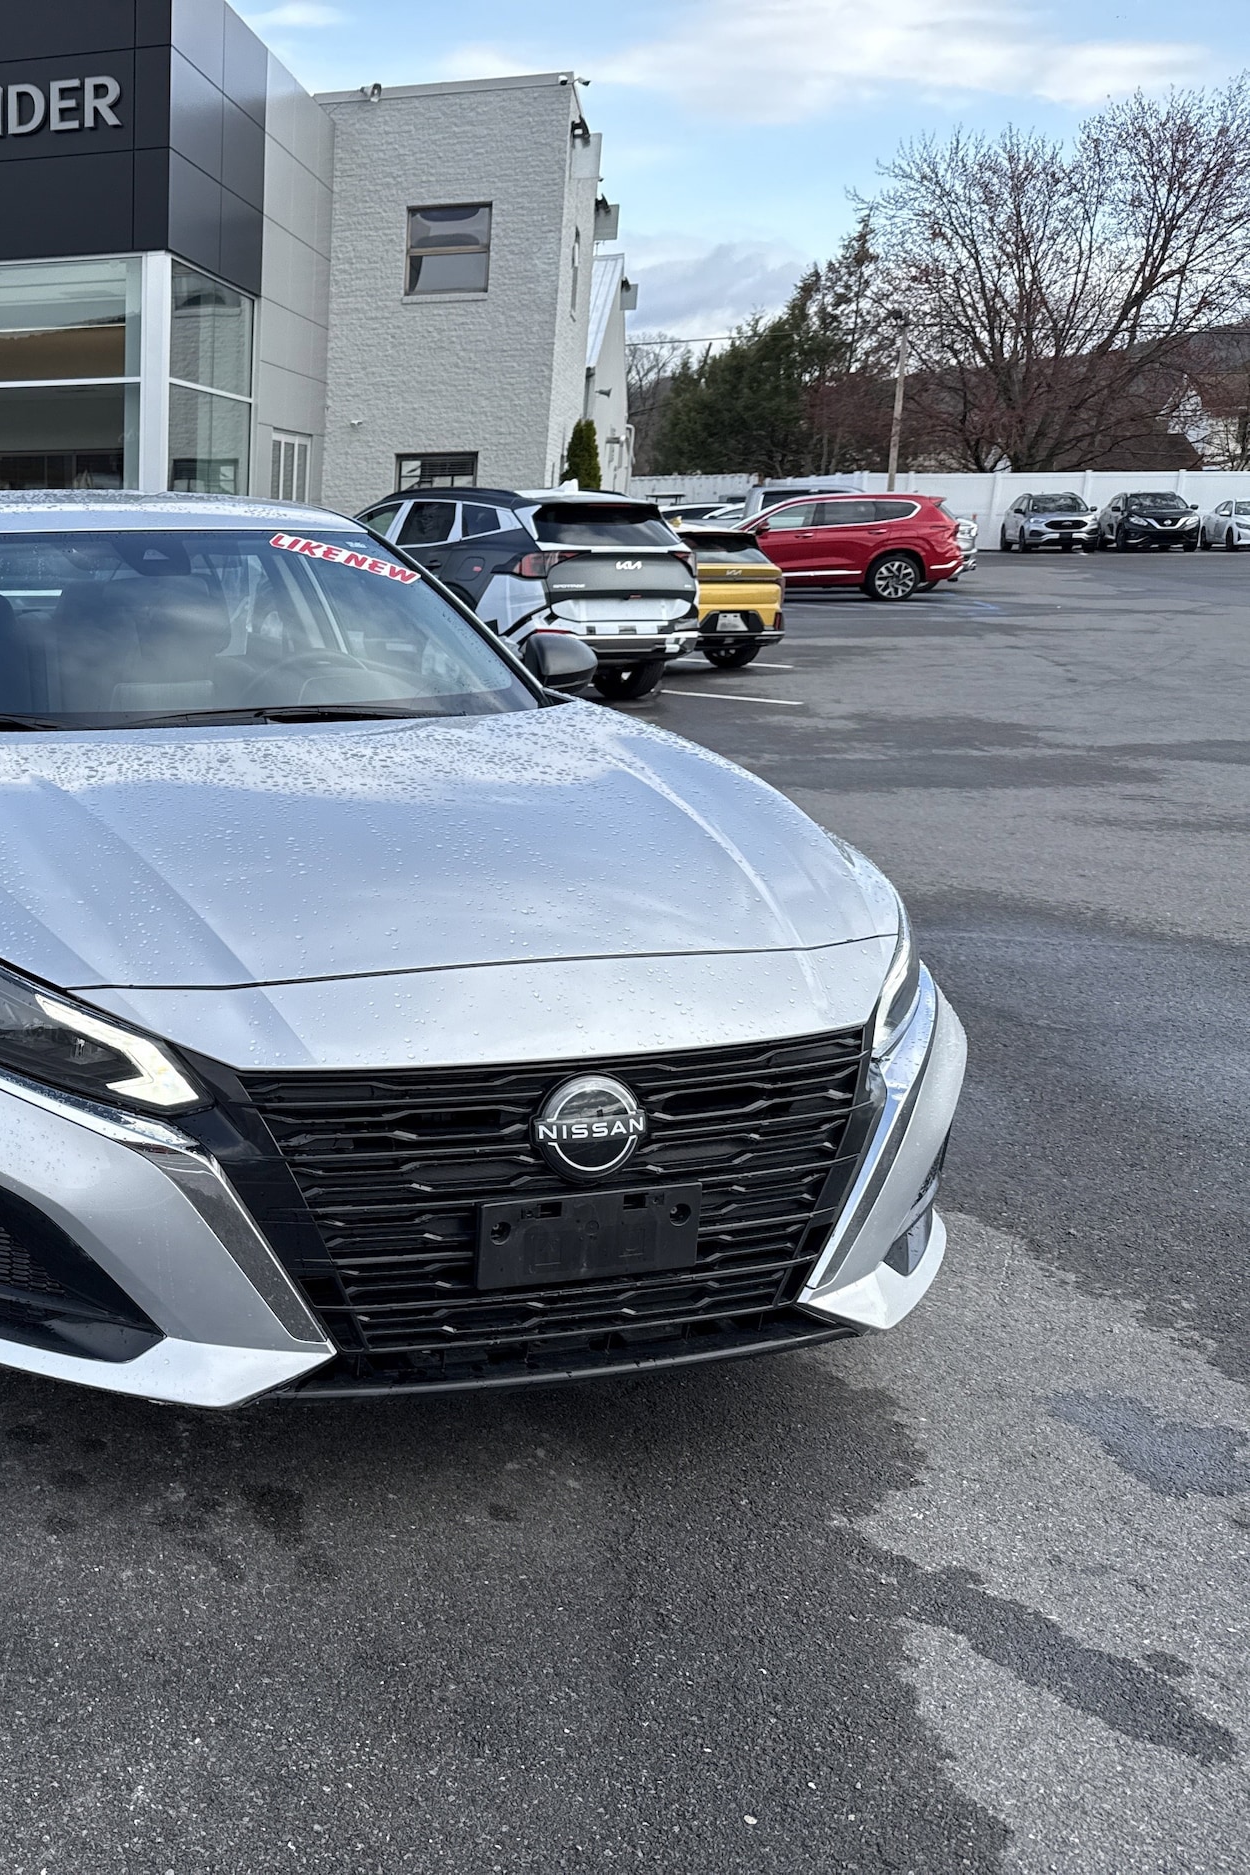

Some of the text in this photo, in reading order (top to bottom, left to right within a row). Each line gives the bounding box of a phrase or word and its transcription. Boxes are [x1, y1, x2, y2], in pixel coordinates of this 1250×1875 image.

[271, 534, 417, 583] LIKE NEW
[538, 1116, 644, 1140] NISSAN
